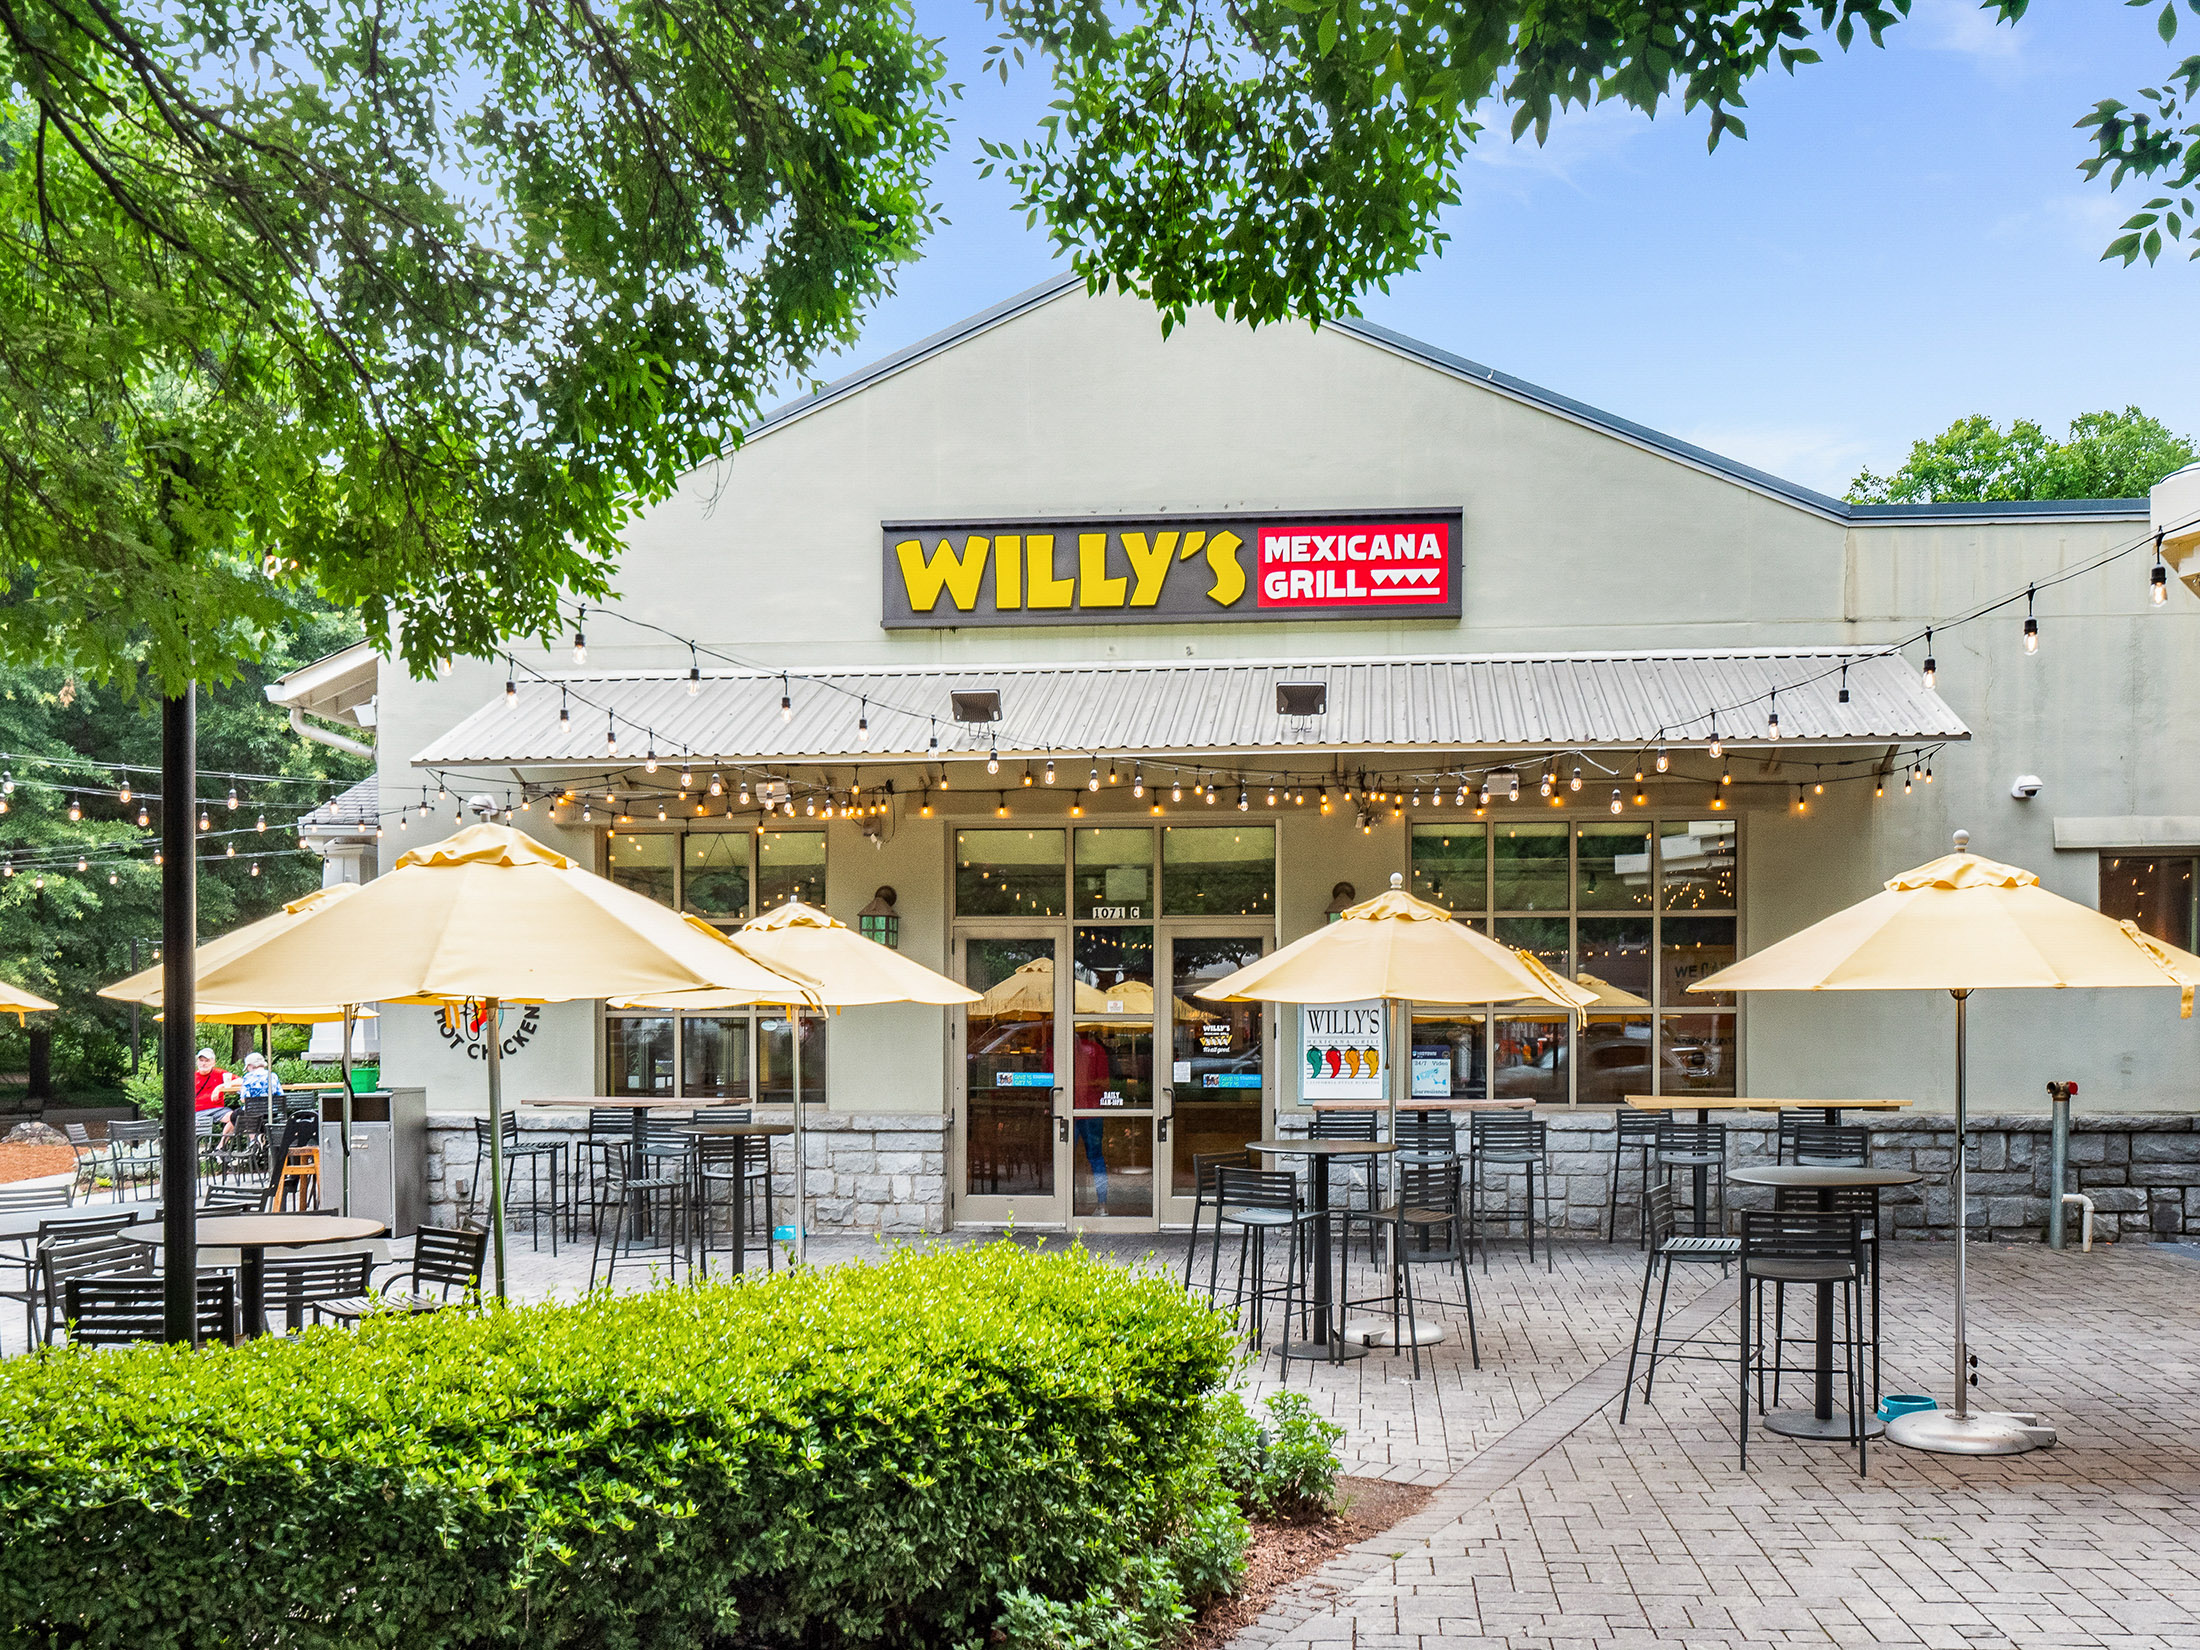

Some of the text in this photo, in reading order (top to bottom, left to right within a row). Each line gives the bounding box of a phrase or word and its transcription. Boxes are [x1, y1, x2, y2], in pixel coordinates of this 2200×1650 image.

[1264, 532, 1442, 564] MEXICANA
[895, 529, 1246, 612] WILLY'S
[1264, 568, 1368, 600] GRILL
[1094, 907, 1139, 919] 1071 C
[1674, 965, 1697, 977] WE
[434, 1007, 465, 1050] HOT
[1307, 1009, 1380, 1035] WILLY'S
